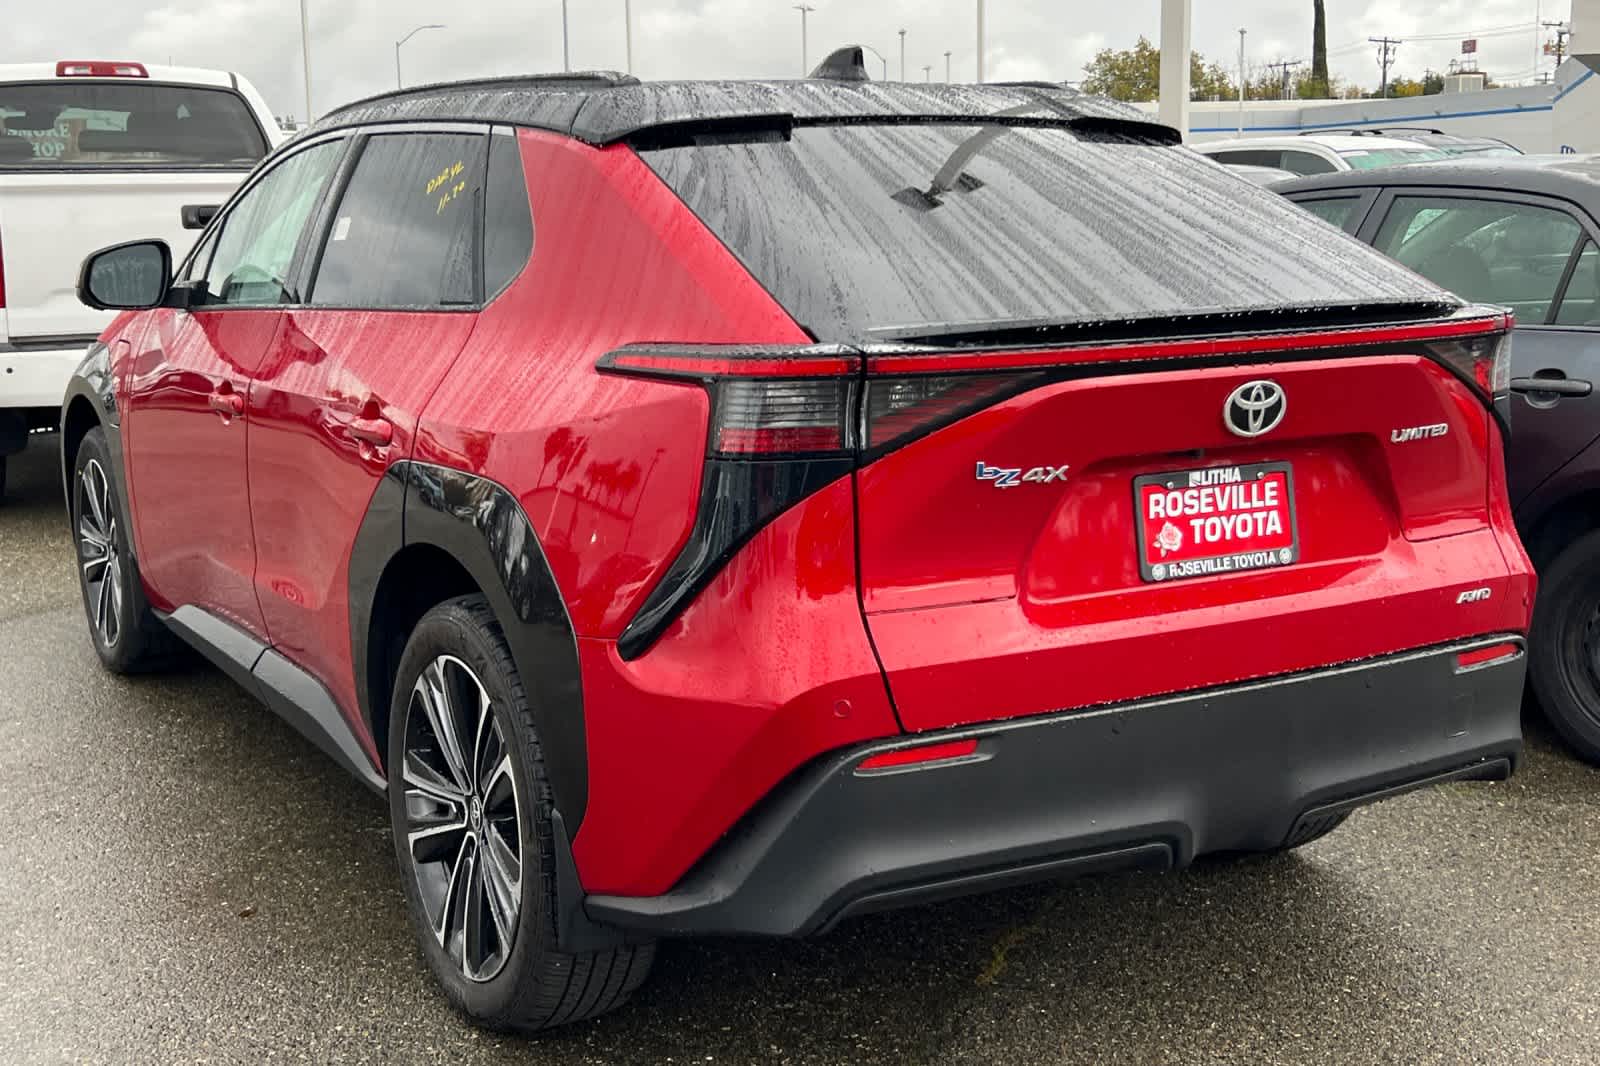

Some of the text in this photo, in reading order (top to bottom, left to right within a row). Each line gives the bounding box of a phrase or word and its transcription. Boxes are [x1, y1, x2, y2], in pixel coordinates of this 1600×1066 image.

[1391, 423, 1449, 443] LIMITED
[1201, 466, 1241, 486] LITHIA
[1149, 481, 1278, 519] ROSEVILLE
[1190, 510, 1282, 544] TOYOTA
[1169, 551, 1277, 577] ROSEVILLE TOYOTA
[1456, 587, 1491, 604] AWD
